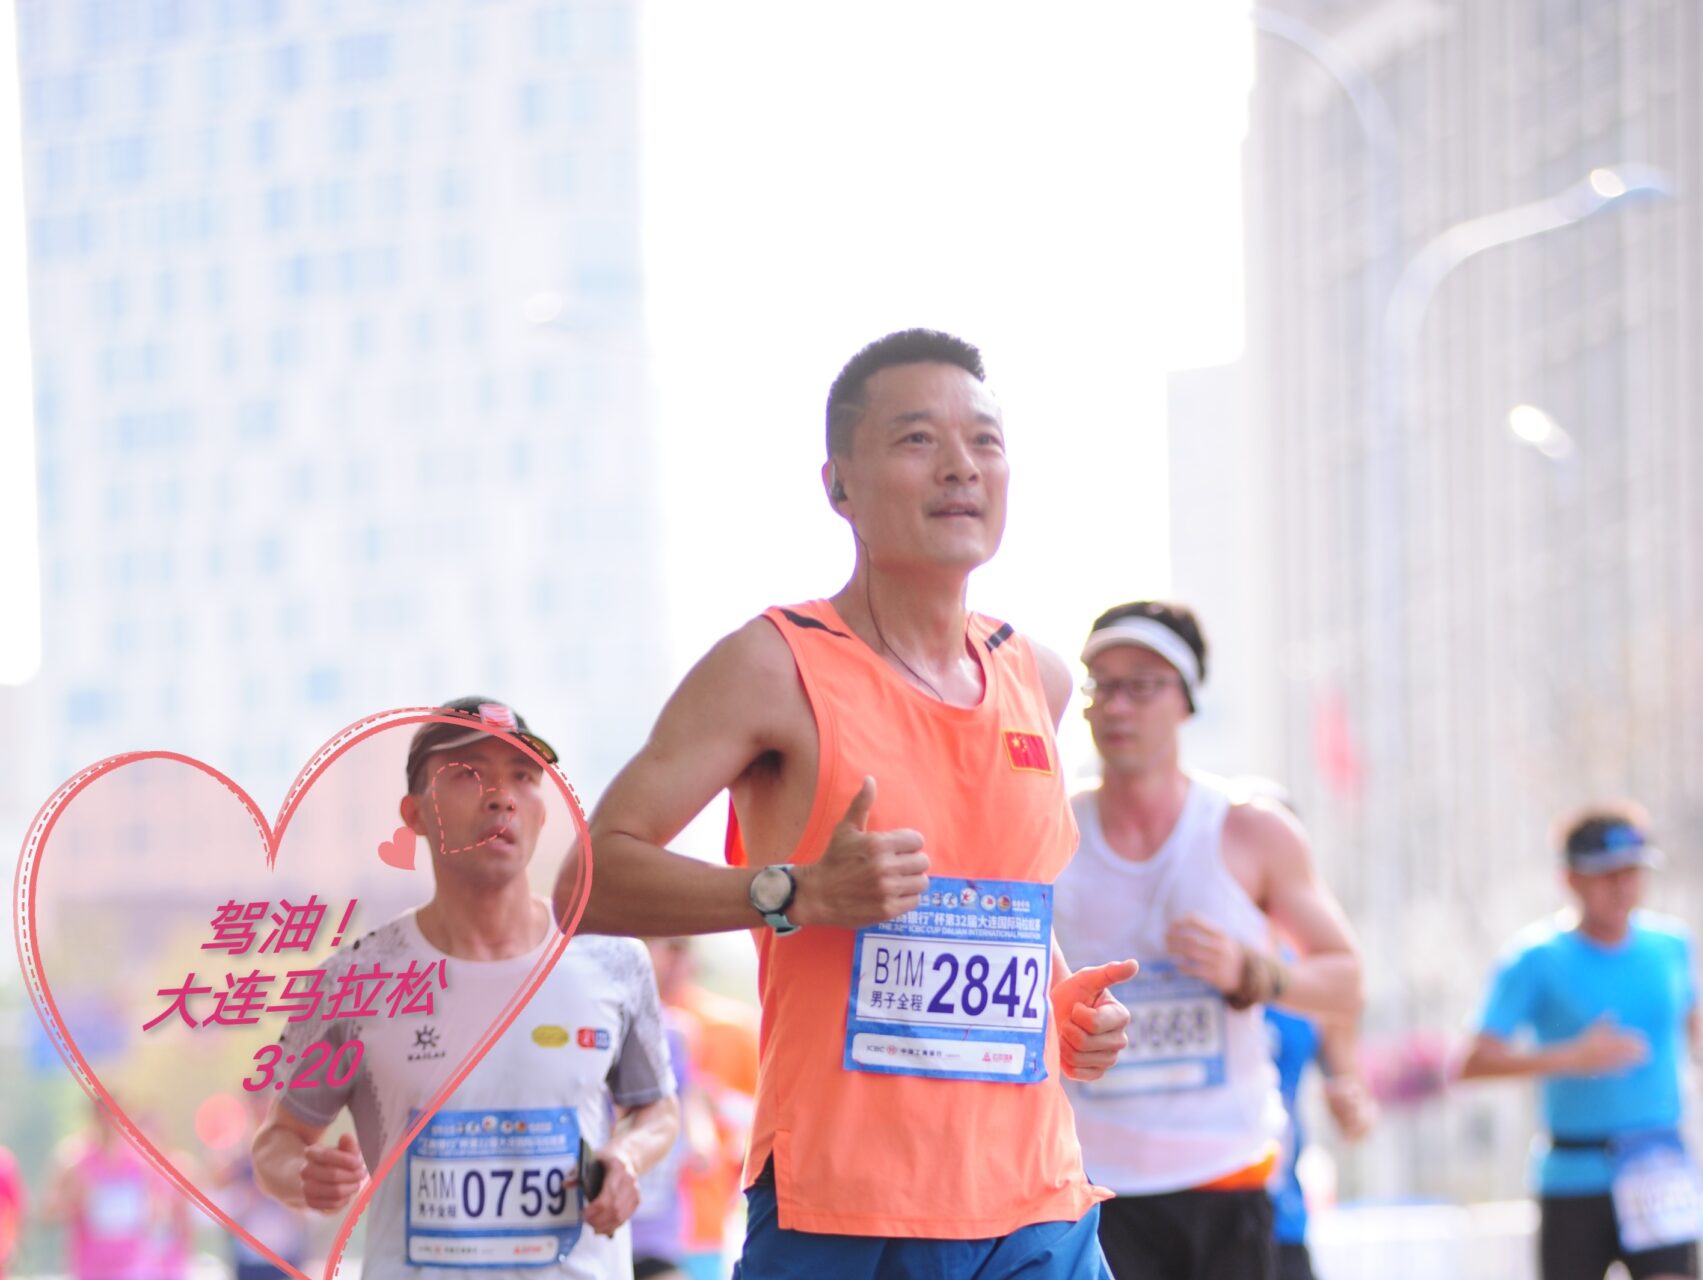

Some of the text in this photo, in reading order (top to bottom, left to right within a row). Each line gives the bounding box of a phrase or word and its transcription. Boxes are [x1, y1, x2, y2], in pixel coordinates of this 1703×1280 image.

[908, 924, 926, 933] ICBC
[926, 926, 942, 934] CUP
[941, 927, 967, 936] DALIAN
[967, 929, 1017, 939] INTERNATIONAL
[870, 990, 924, 1013] 男子全程
[874, 947, 1039, 1019] B1M 2842
[417, 1168, 567, 1219] A1M 0759
